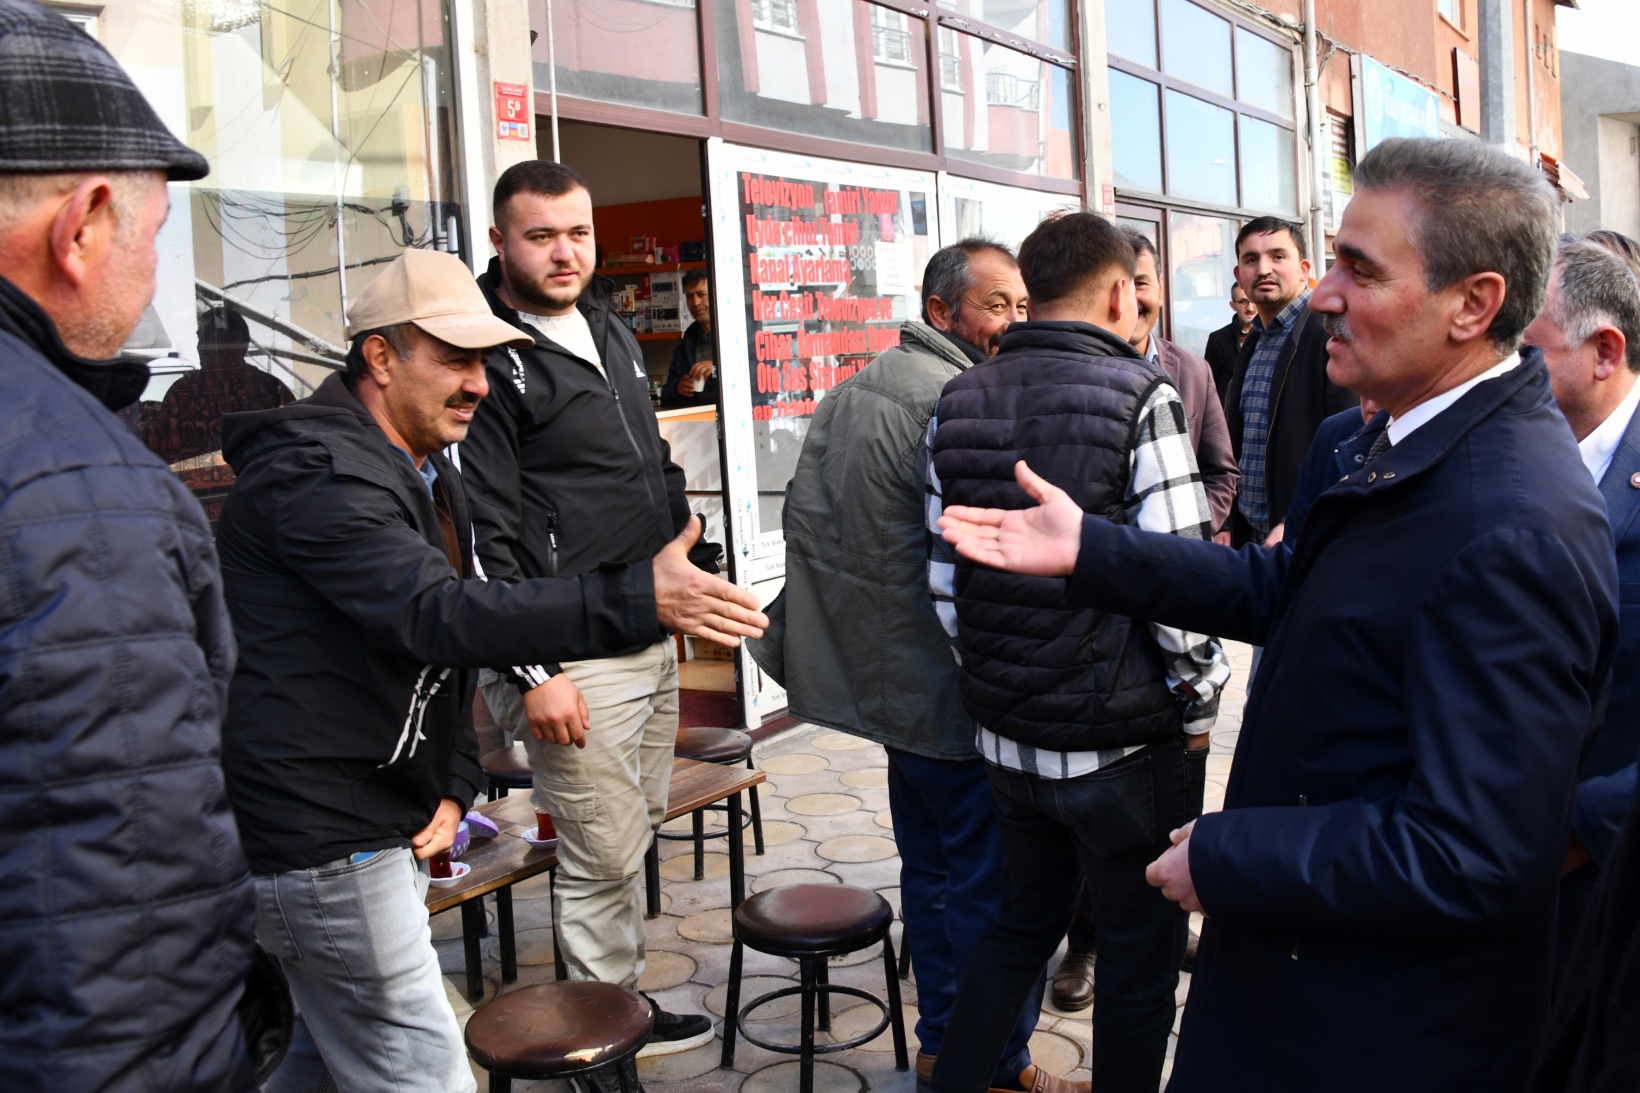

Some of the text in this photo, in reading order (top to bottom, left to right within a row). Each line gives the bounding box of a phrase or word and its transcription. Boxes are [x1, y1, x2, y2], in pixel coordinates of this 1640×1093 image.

[742, 172, 815, 211] Televizyon
[746, 214, 782, 248] Uydu
[819, 217, 858, 246] Tamiri
[750, 252, 850, 286] Kanal Ayarlama
[752, 290, 778, 322] Her
[815, 291, 878, 324] Televizyon
[880, 296, 892, 320] ve
[754, 330, 794, 362] Cihaz
[796, 325, 866, 359] Kumandası
[756, 360, 857, 394] Oto Ses Sistemi
[752, 404, 773, 421] ep
